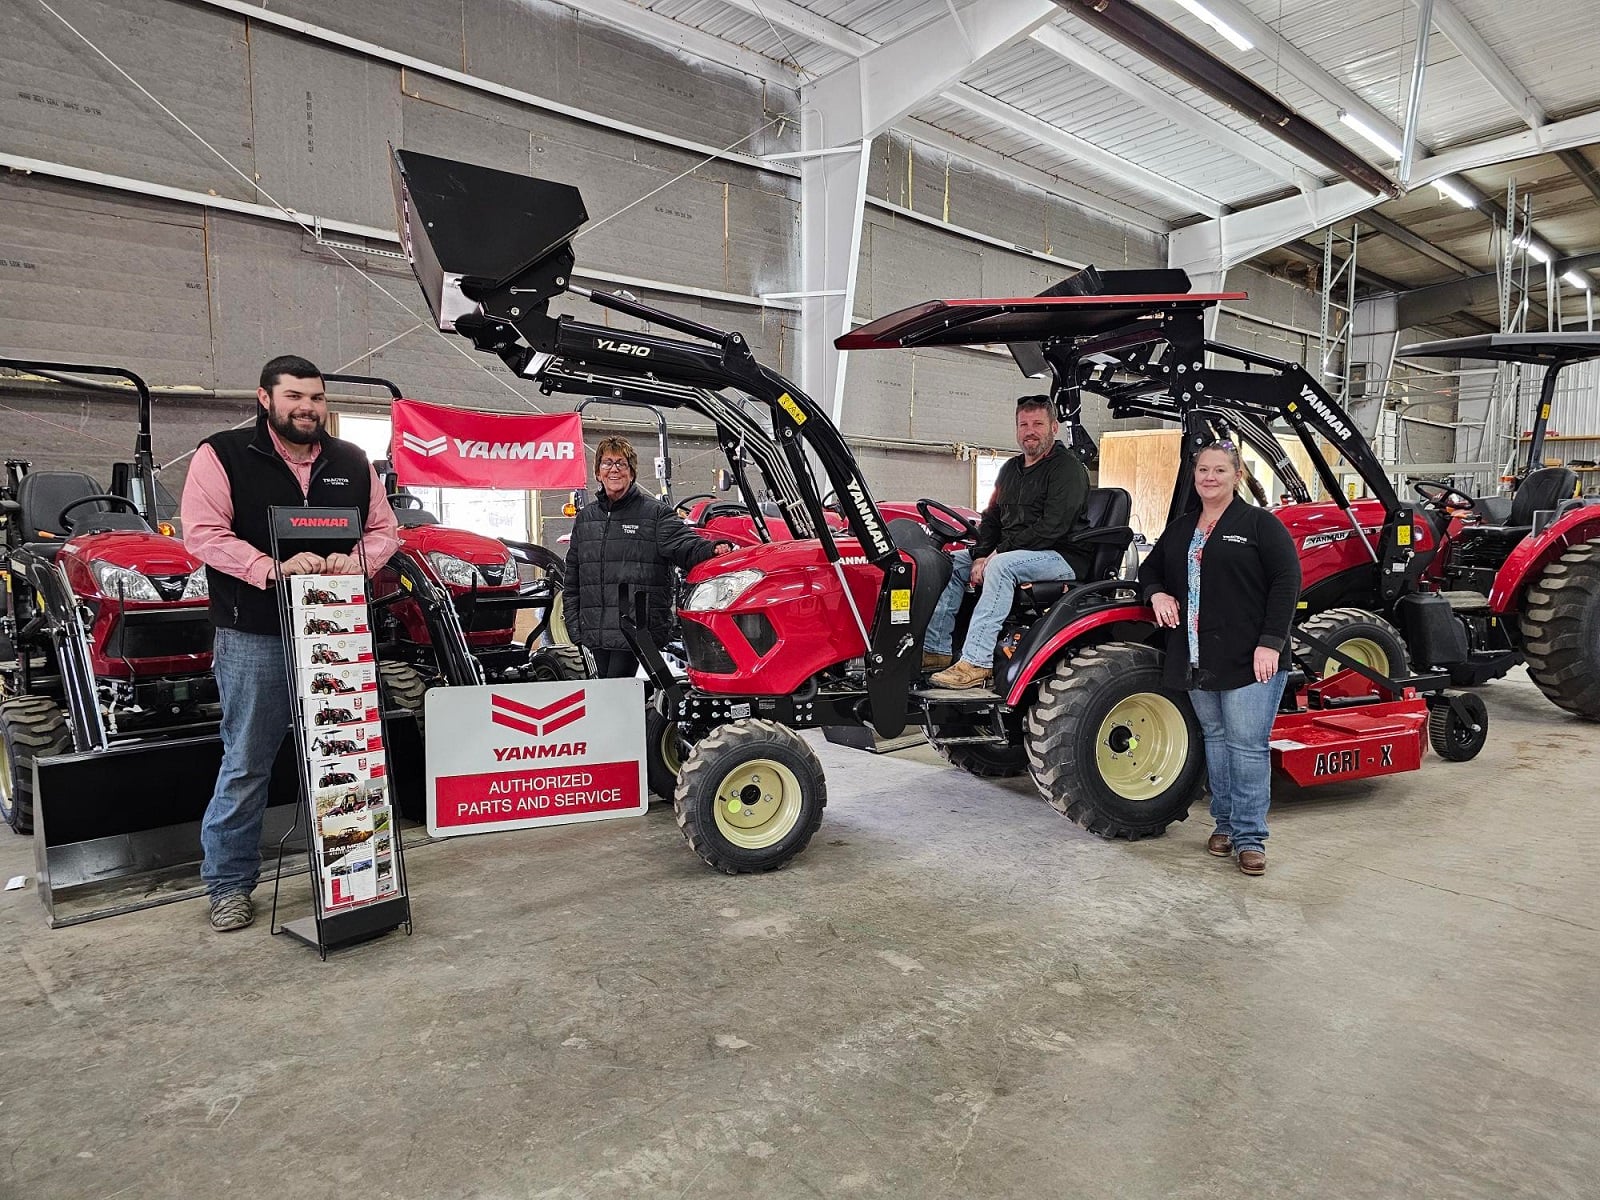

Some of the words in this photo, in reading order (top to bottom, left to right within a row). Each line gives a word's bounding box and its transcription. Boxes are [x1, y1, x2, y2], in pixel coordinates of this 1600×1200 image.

[597, 338, 651, 357] YL210
[1300, 384, 1352, 441] YANMAR
[453, 438, 575, 460] YANMAR
[290, 517, 349, 528] YANMAR
[847, 478, 890, 556] YANMAR
[1309, 532, 1346, 545] YANMAR
[493, 741, 587, 762] YANMAR
[1313, 748, 1361, 777] AGRI
[1381, 744, 1393, 767] X
[488, 773, 593, 795] AUTHORIZED
[457, 799, 513, 817] PARTS
[516, 795, 551, 811] AND
[554, 788, 622, 808] SERVICE
